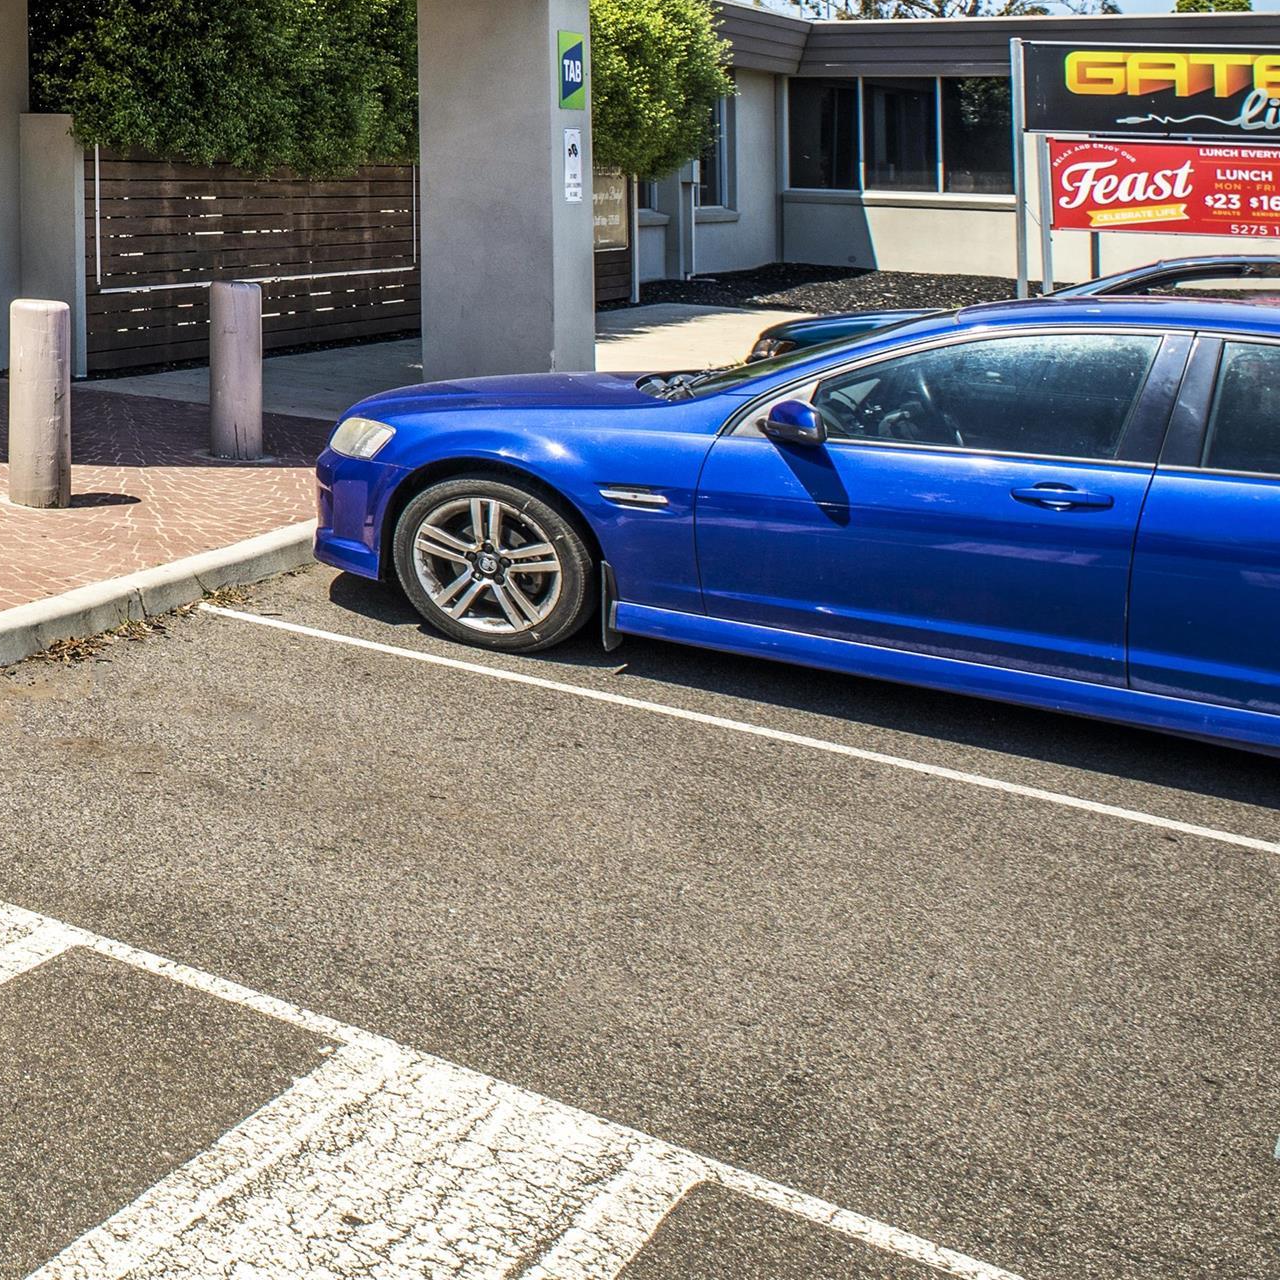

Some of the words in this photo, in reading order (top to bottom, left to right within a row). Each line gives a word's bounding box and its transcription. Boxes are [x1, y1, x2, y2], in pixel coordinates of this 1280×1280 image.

[563, 59, 582, 83] TAB
[1074, 143, 1090, 151] AND
[1121, 151, 1137, 163] OUR
[1200, 148, 1239, 157] LUNCH
[1241, 150, 1280, 159] EVERY
[1216, 169, 1273, 182] LUNCH
[1059, 158, 1195, 209] Feast
[1214, 182, 1241, 191] MON
[1256, 184, 1276, 192] FRI
[1204, 193, 1241, 210] $23
[1096, 210, 1153, 222] CELEBRATE
[1154, 207, 1178, 218] LIFE
[1230, 224, 1269, 236] 5275
